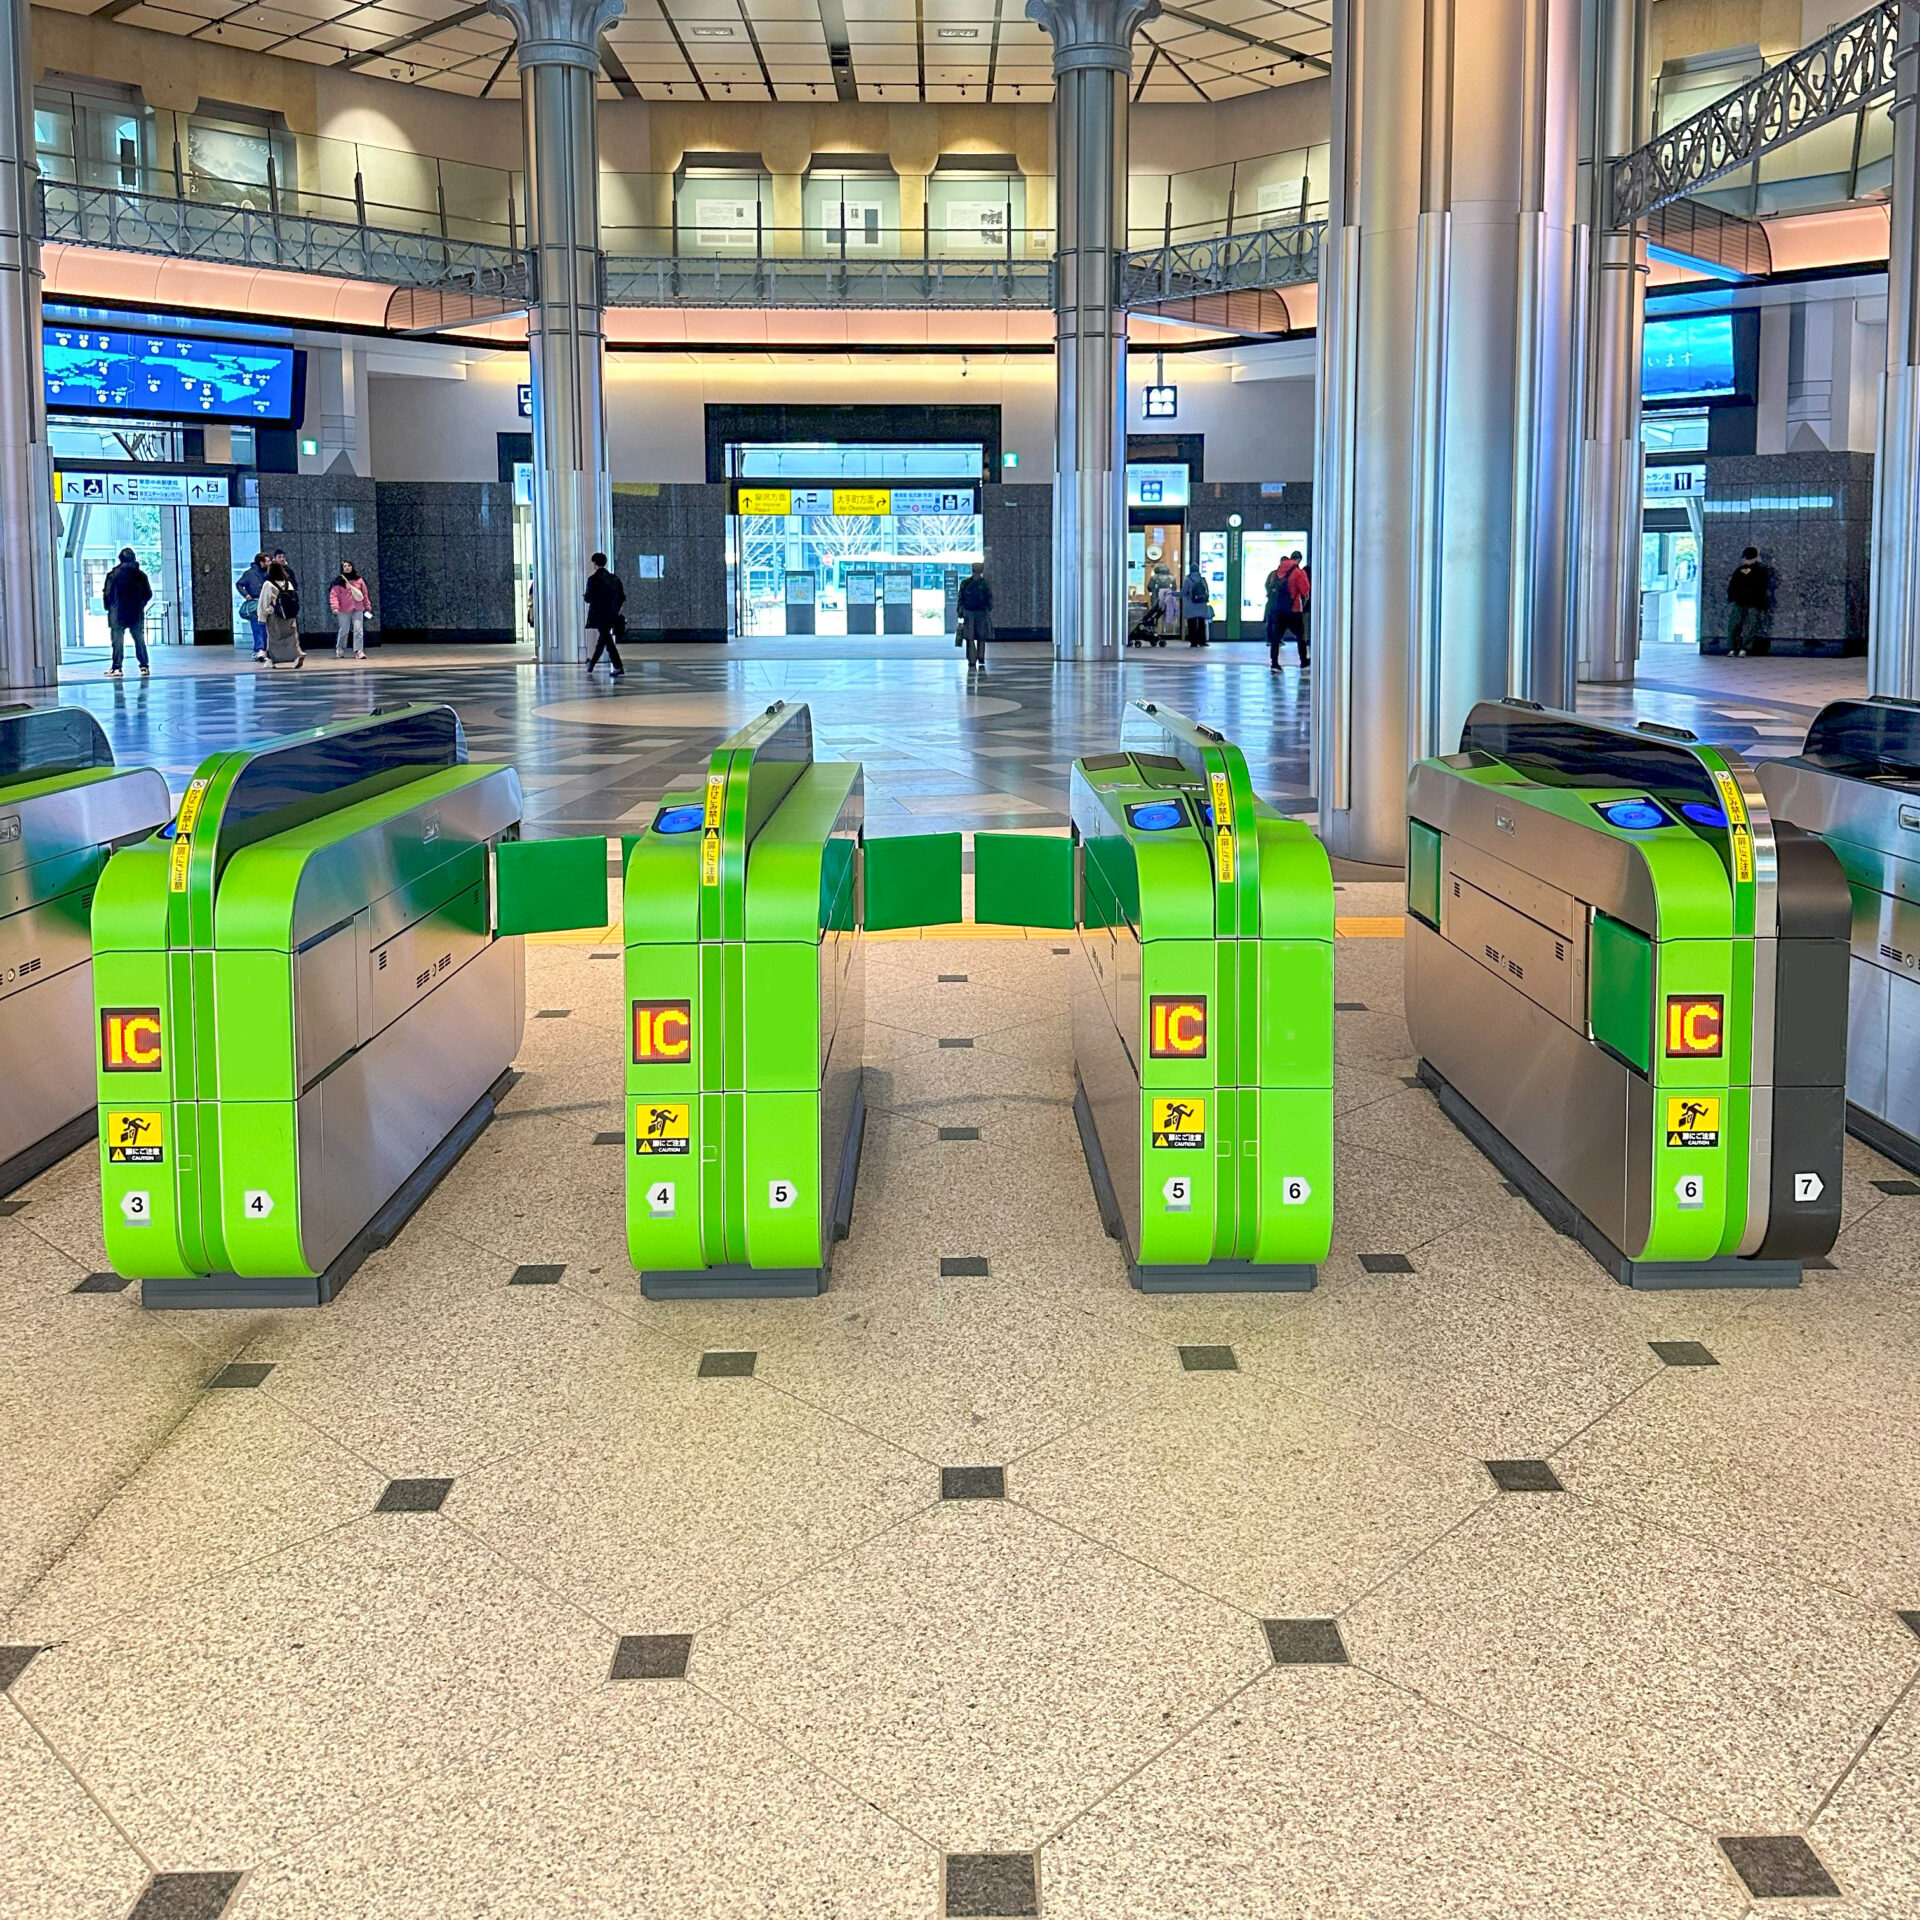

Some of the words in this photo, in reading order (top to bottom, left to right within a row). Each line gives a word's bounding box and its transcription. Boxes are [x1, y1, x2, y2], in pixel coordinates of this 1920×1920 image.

[1647, 352, 1694, 368] います
[837, 494, 875, 504] 大手町方面
[180, 789, 201, 831] かけこみ禁止
[708, 785, 721, 826] かけこみ禁止
[1215, 782, 1229, 823] かけこみ禁止
[1722, 780, 1744, 822] かけこみ禁止
[174, 847, 187, 890] 扉にご注意
[706, 841, 717, 884] 扉にご注意
[1220, 838, 1232, 881] 扉にご注意
[1737, 837, 1750, 880] 扉にご注意
[109, 1017, 161, 1064] IC
[639, 1010, 689, 1056] IC
[1155, 1005, 1203, 1051] IC
[1670, 1004, 1719, 1050] IC
[131, 1196, 144, 1213] 3
[251, 1196, 264, 1212] 4
[656, 1188, 669, 1204] 4
[775, 1186, 788, 1202] 5
[1172, 1182, 1185, 1199] 5
[1289, 1182, 1301, 1199] 6
[1685, 1181, 1697, 1198] 6
[1801, 1179, 1813, 1195] 7
